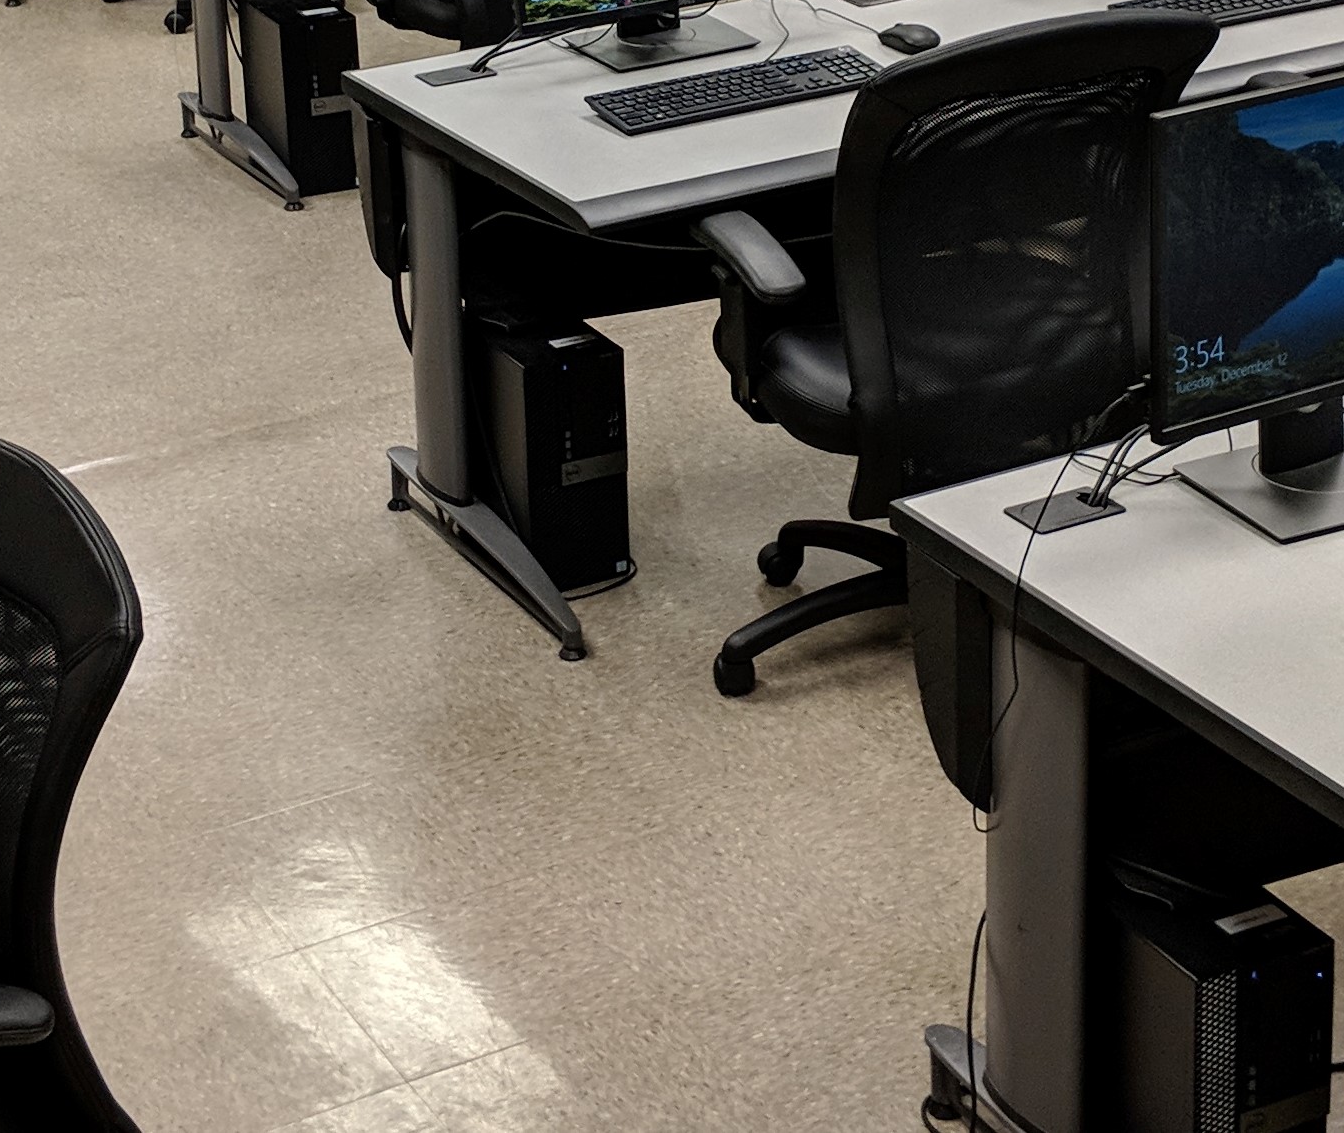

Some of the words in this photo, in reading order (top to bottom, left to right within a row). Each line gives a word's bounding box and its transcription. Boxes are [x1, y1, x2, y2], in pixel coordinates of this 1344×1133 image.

[1174, 335, 1226, 374] 3:54
[1174, 374, 1219, 395] Tuesday,
[1220, 357, 1275, 384] December
[1277, 352, 1290, 367] 12
